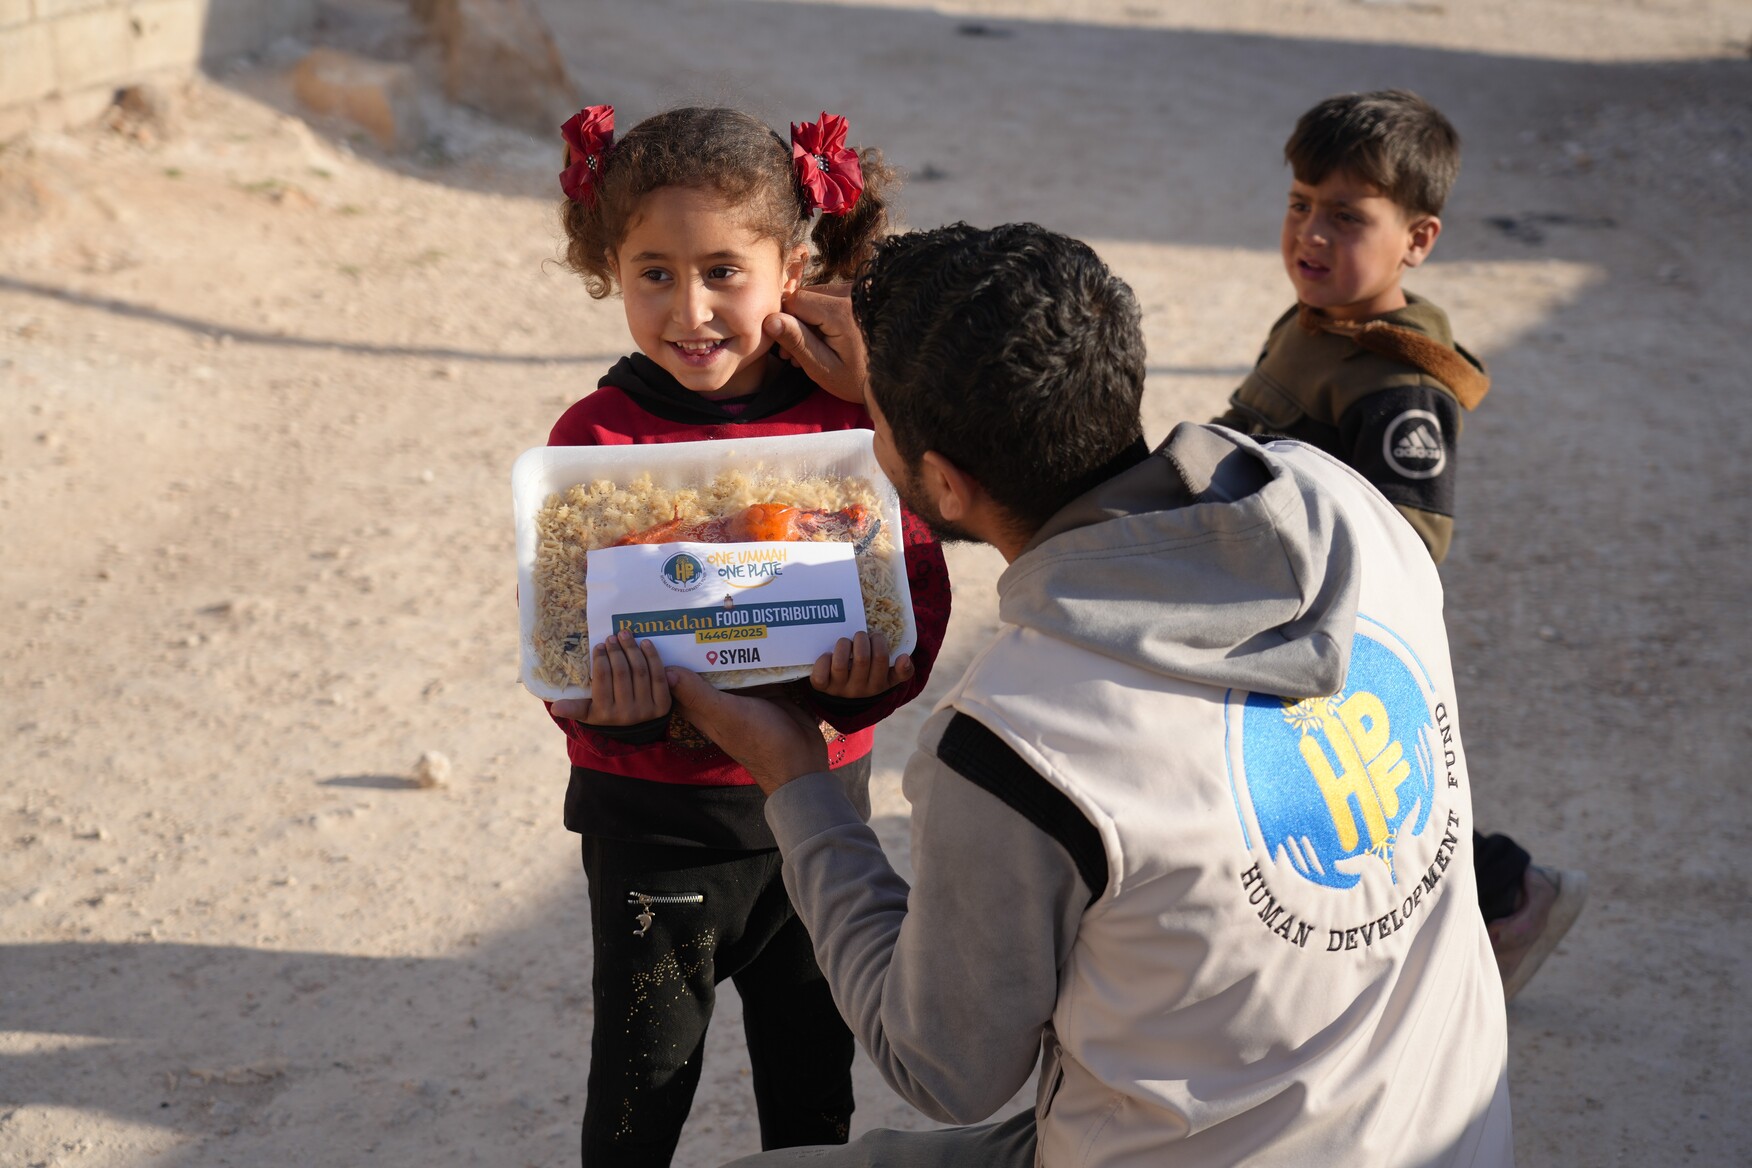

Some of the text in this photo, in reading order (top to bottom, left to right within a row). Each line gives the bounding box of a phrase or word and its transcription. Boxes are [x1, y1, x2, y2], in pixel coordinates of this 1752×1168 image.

[707, 548, 787, 567] ONE UMMAH
[718, 561, 783, 579] ONE PLATE
[619, 604, 839, 634] Ramadan FOOD DISTRIBUTION
[699, 628, 763, 641] 1446/2025
[719, 647, 761, 665] SYRIA
[1241, 701, 1460, 952] HUMAN DEVELOPMENT FUND
